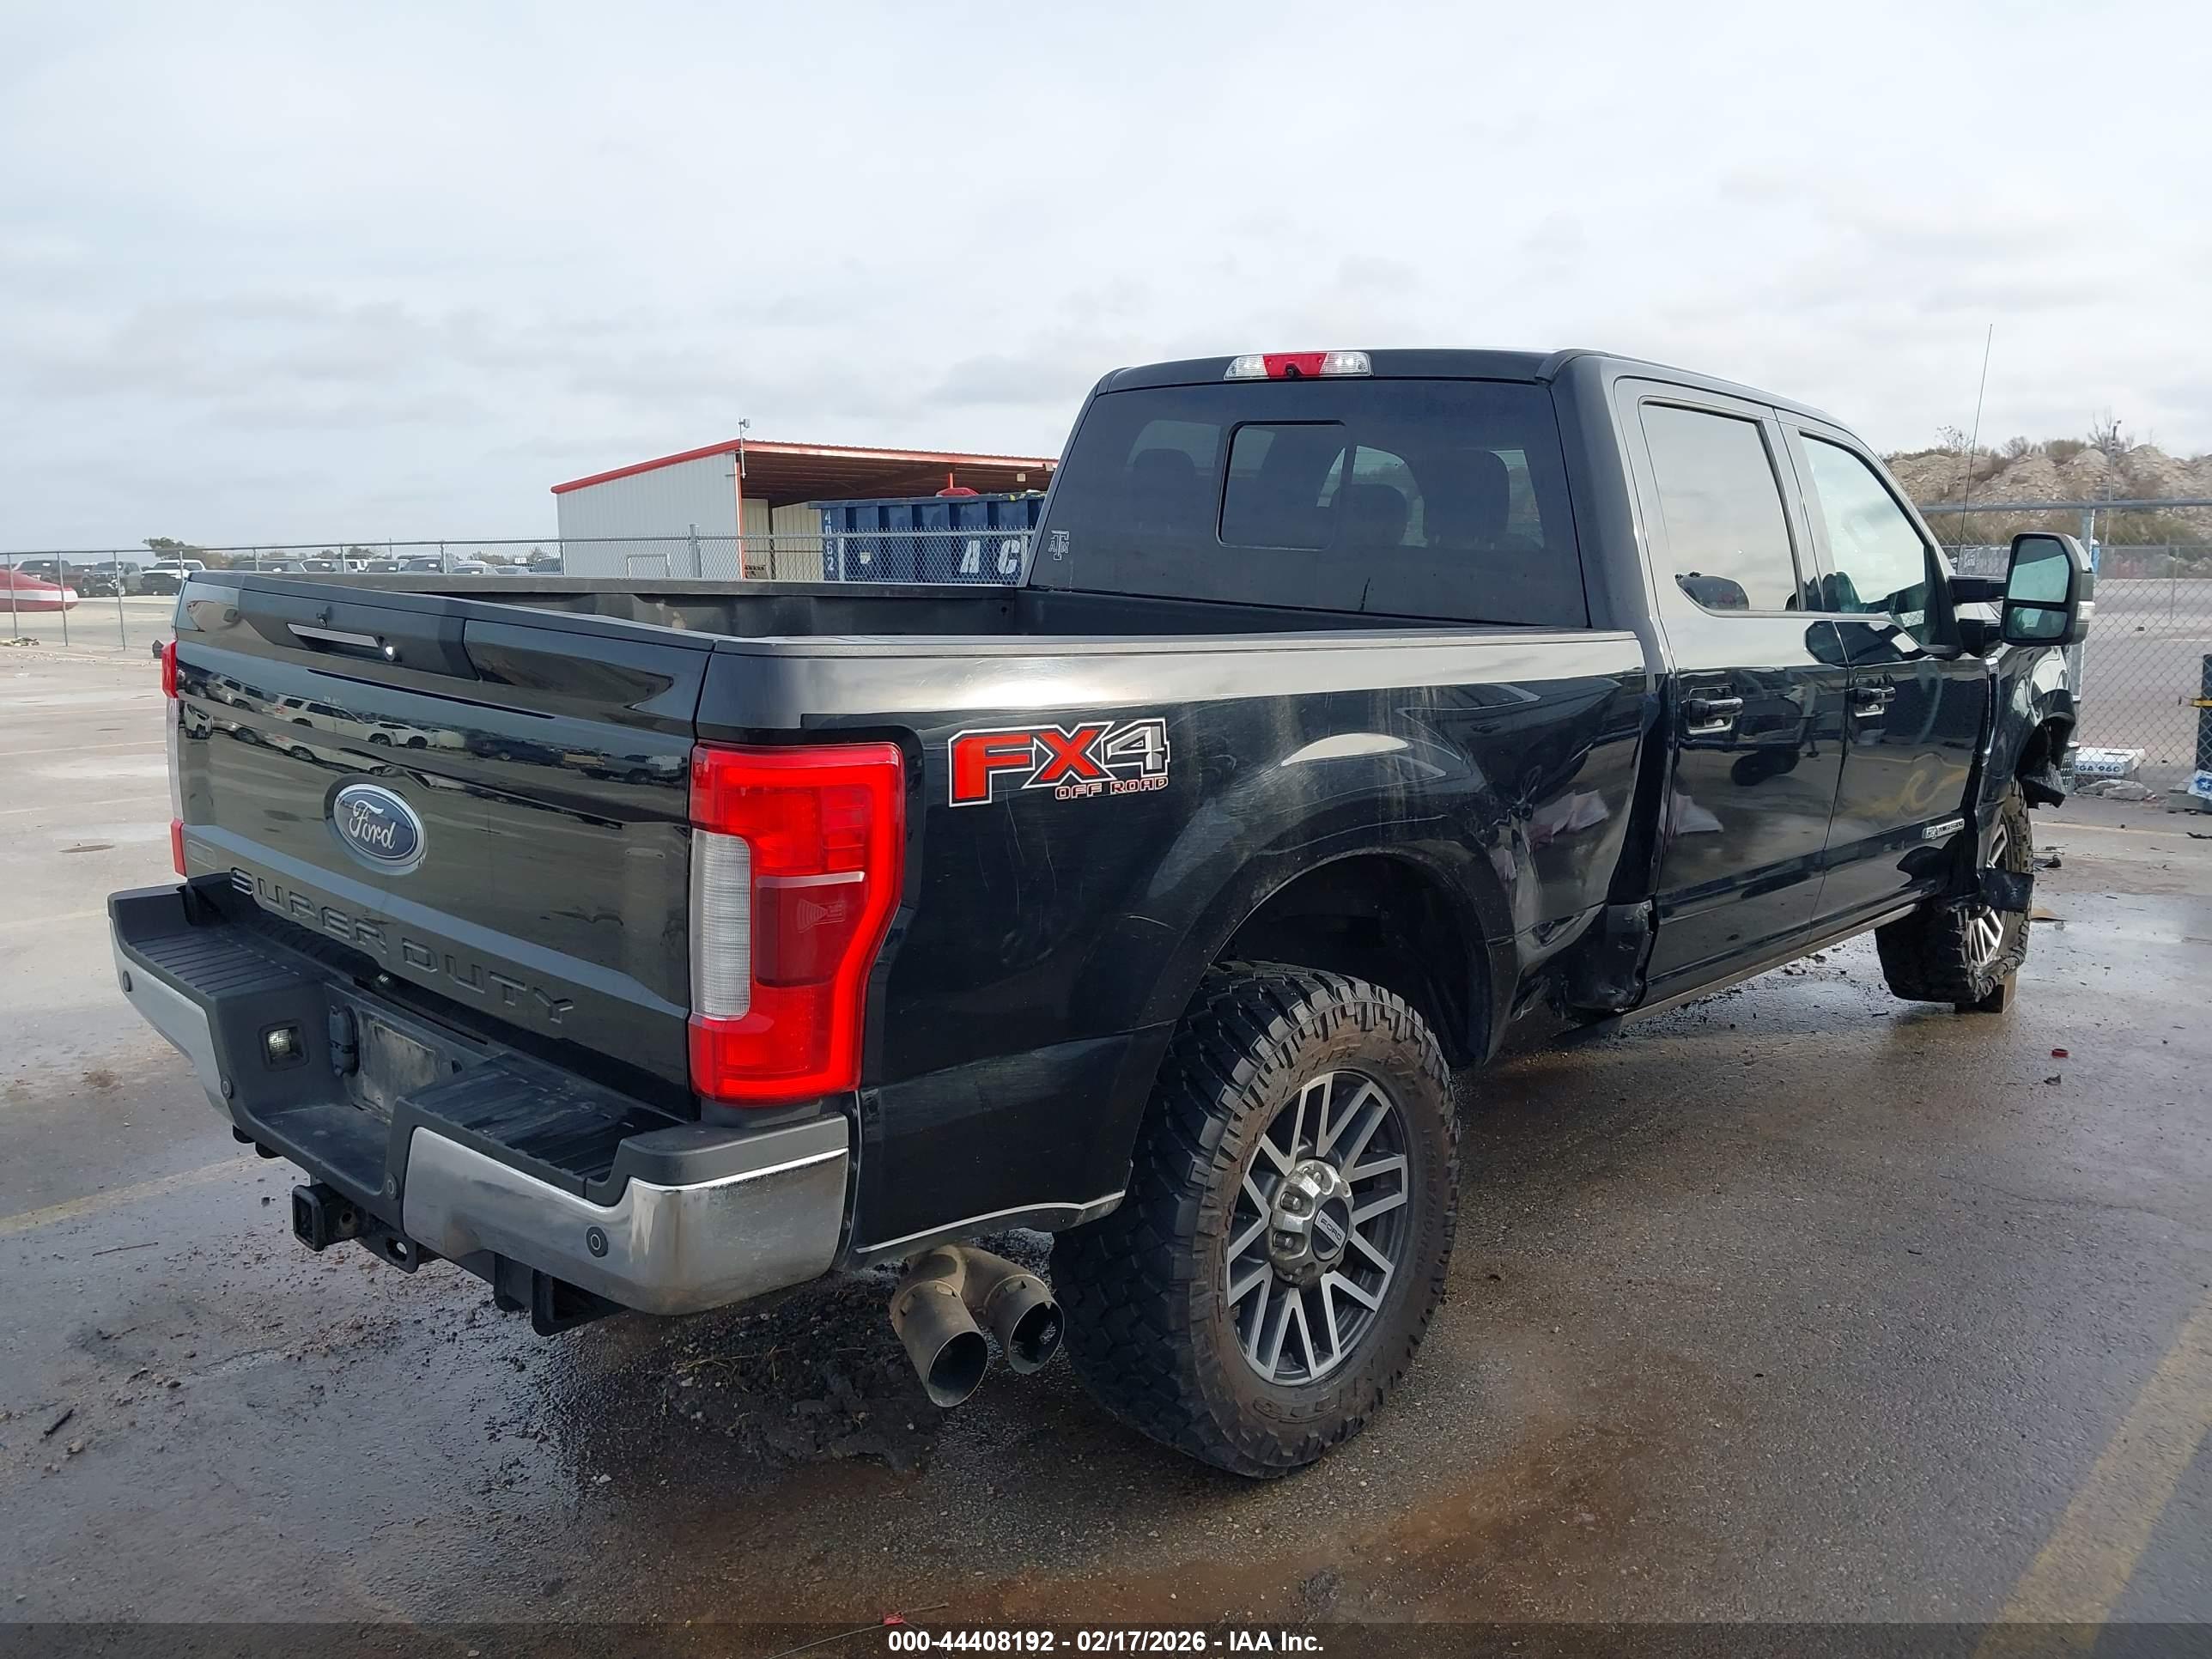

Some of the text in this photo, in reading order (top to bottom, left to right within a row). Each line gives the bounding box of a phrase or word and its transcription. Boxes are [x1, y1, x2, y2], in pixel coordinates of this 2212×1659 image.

[948, 718, 1170, 807] FX4
[1054, 776, 1169, 800] OFF ROAD
[349, 799, 397, 850] Ford
[229, 866, 574, 1024] SUPER DUTY
[1320, 1218, 1342, 1242] FORD
